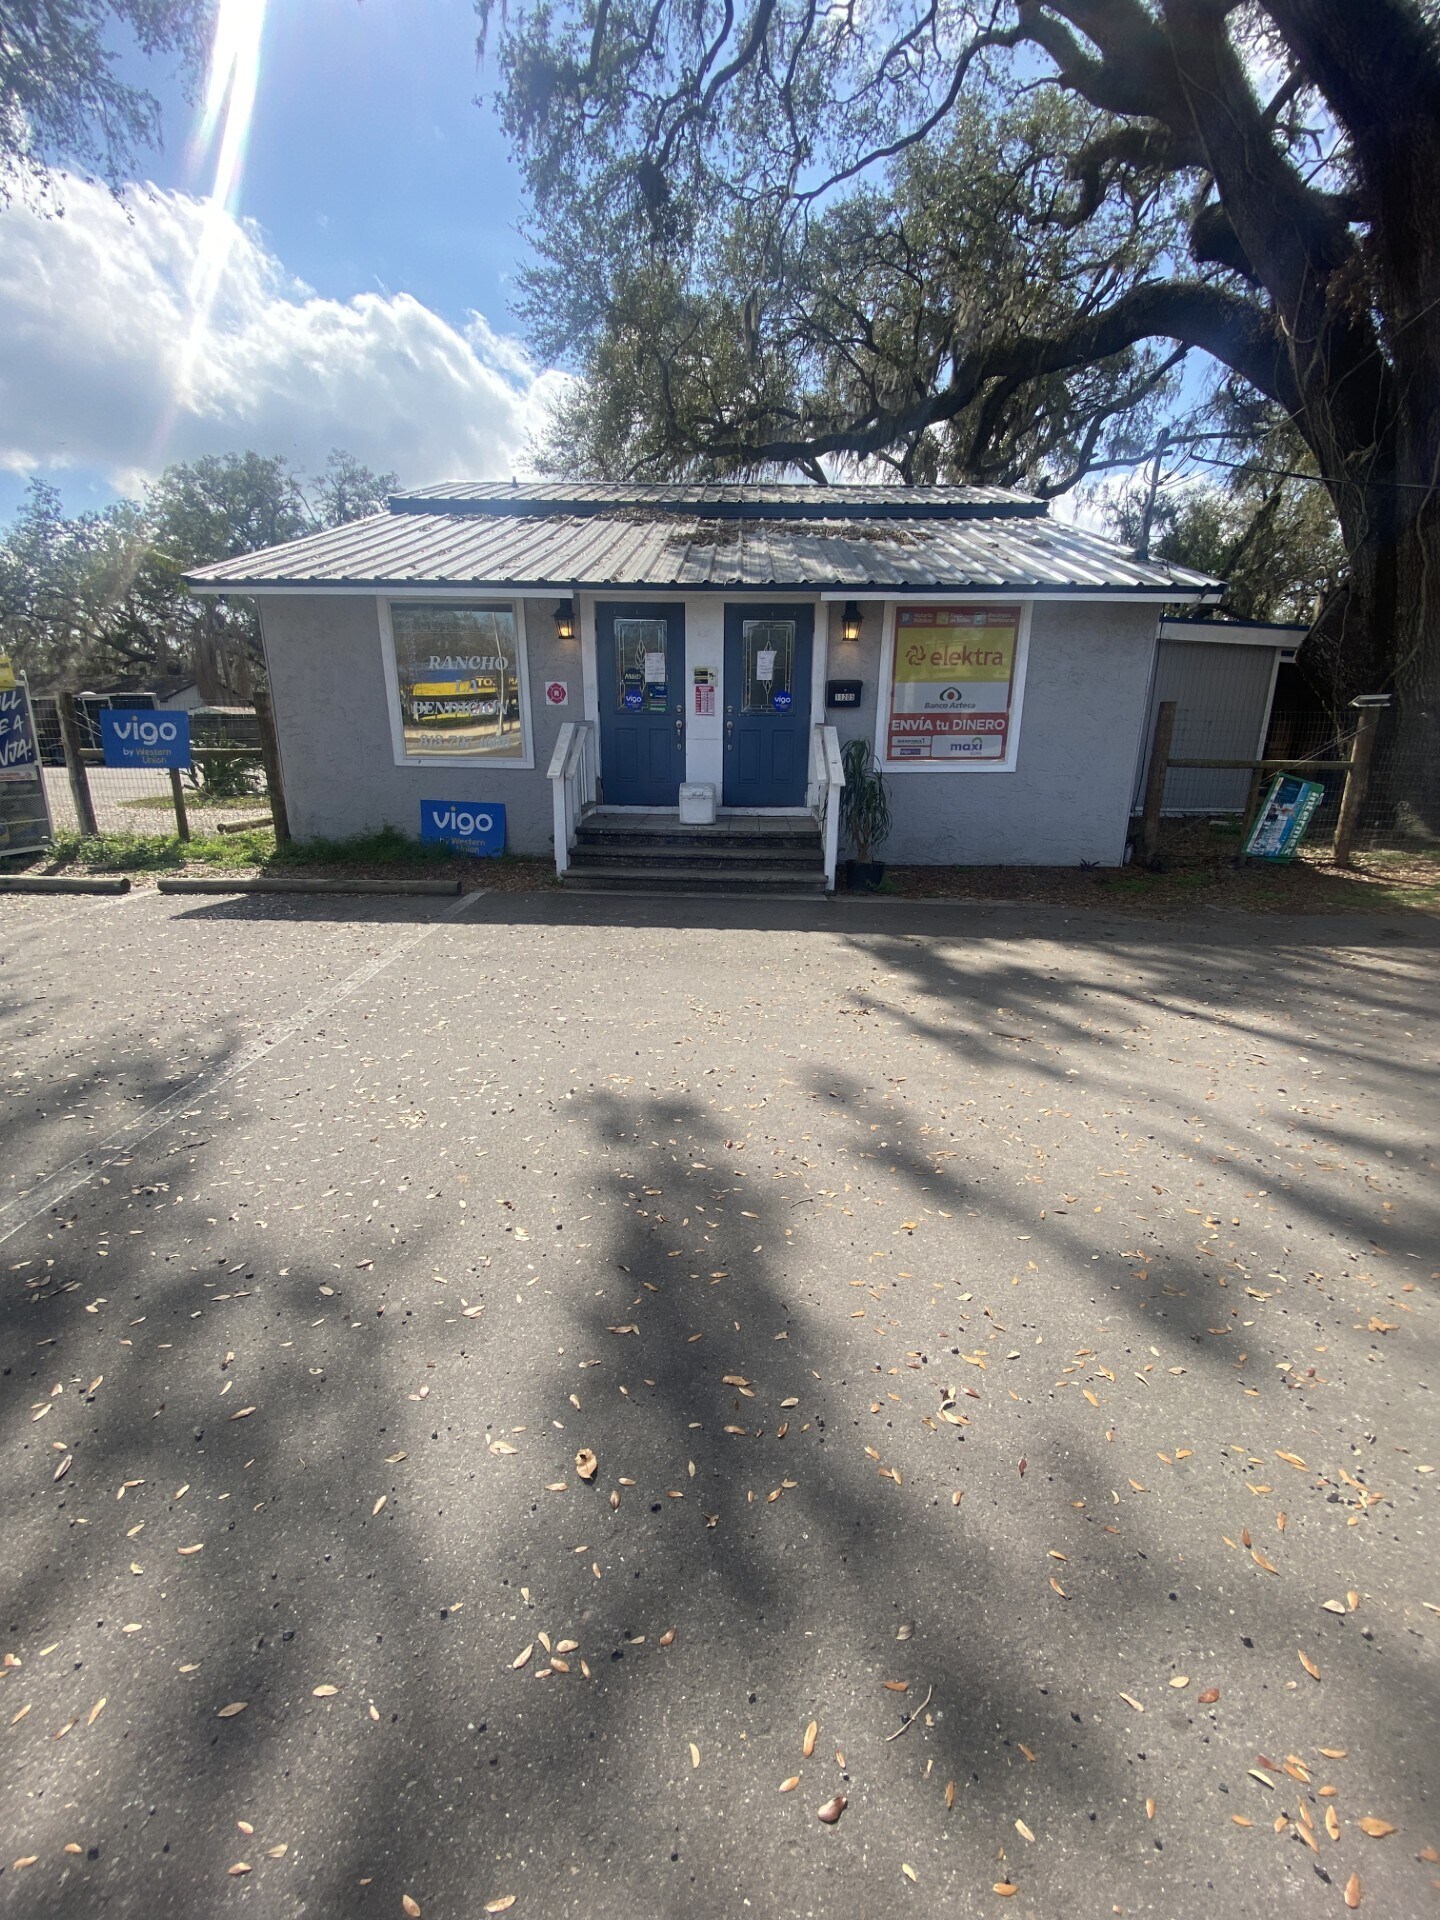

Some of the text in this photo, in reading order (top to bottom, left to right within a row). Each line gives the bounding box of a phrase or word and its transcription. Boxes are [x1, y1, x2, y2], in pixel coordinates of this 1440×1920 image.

[428, 655, 509, 670] RANCHO
[930, 645, 1003, 666] elektra
[455, 679, 479, 694] LA
[626, 695, 642, 703] vigo
[13, 714, 24, 733] A
[112, 715, 177, 746] vigo
[892, 716, 1006, 731] ENVÍA tu DINERO
[122, 748, 134, 756] by
[950, 739, 982, 751] maxi
[432, 806, 493, 836] vigo
